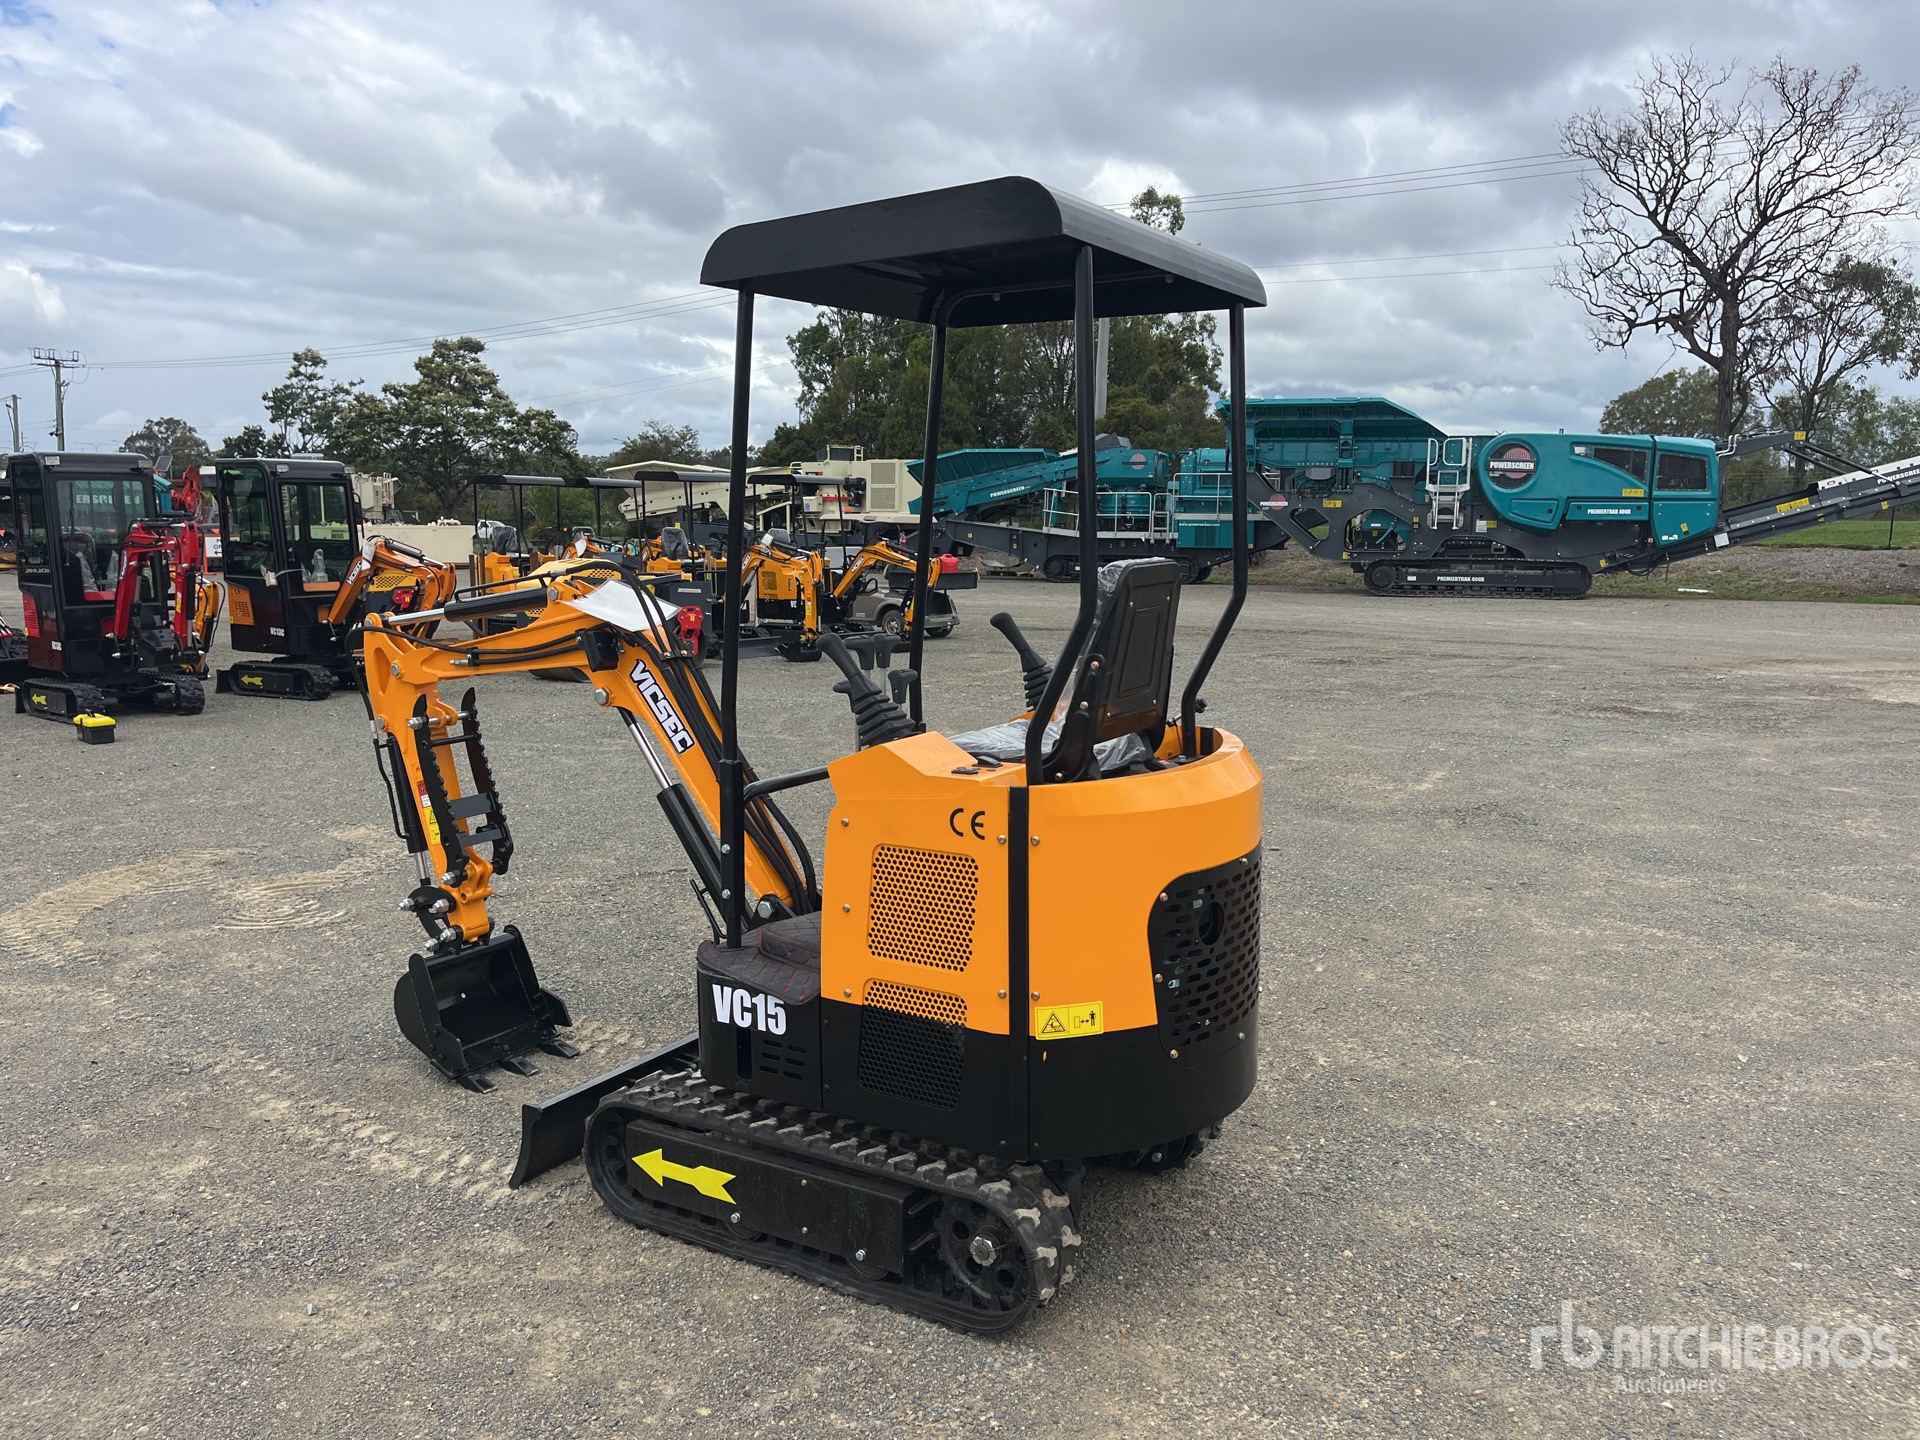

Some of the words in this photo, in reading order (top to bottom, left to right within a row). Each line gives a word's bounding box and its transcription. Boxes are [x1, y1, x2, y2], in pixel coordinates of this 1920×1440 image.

[1489, 461, 1535, 470] POWERSCREEN
[989, 486, 1025, 498] POWERSCREEN
[629, 659, 696, 755] VICSEC
[949, 807, 986, 841] CE
[712, 983, 787, 1036] VC15
